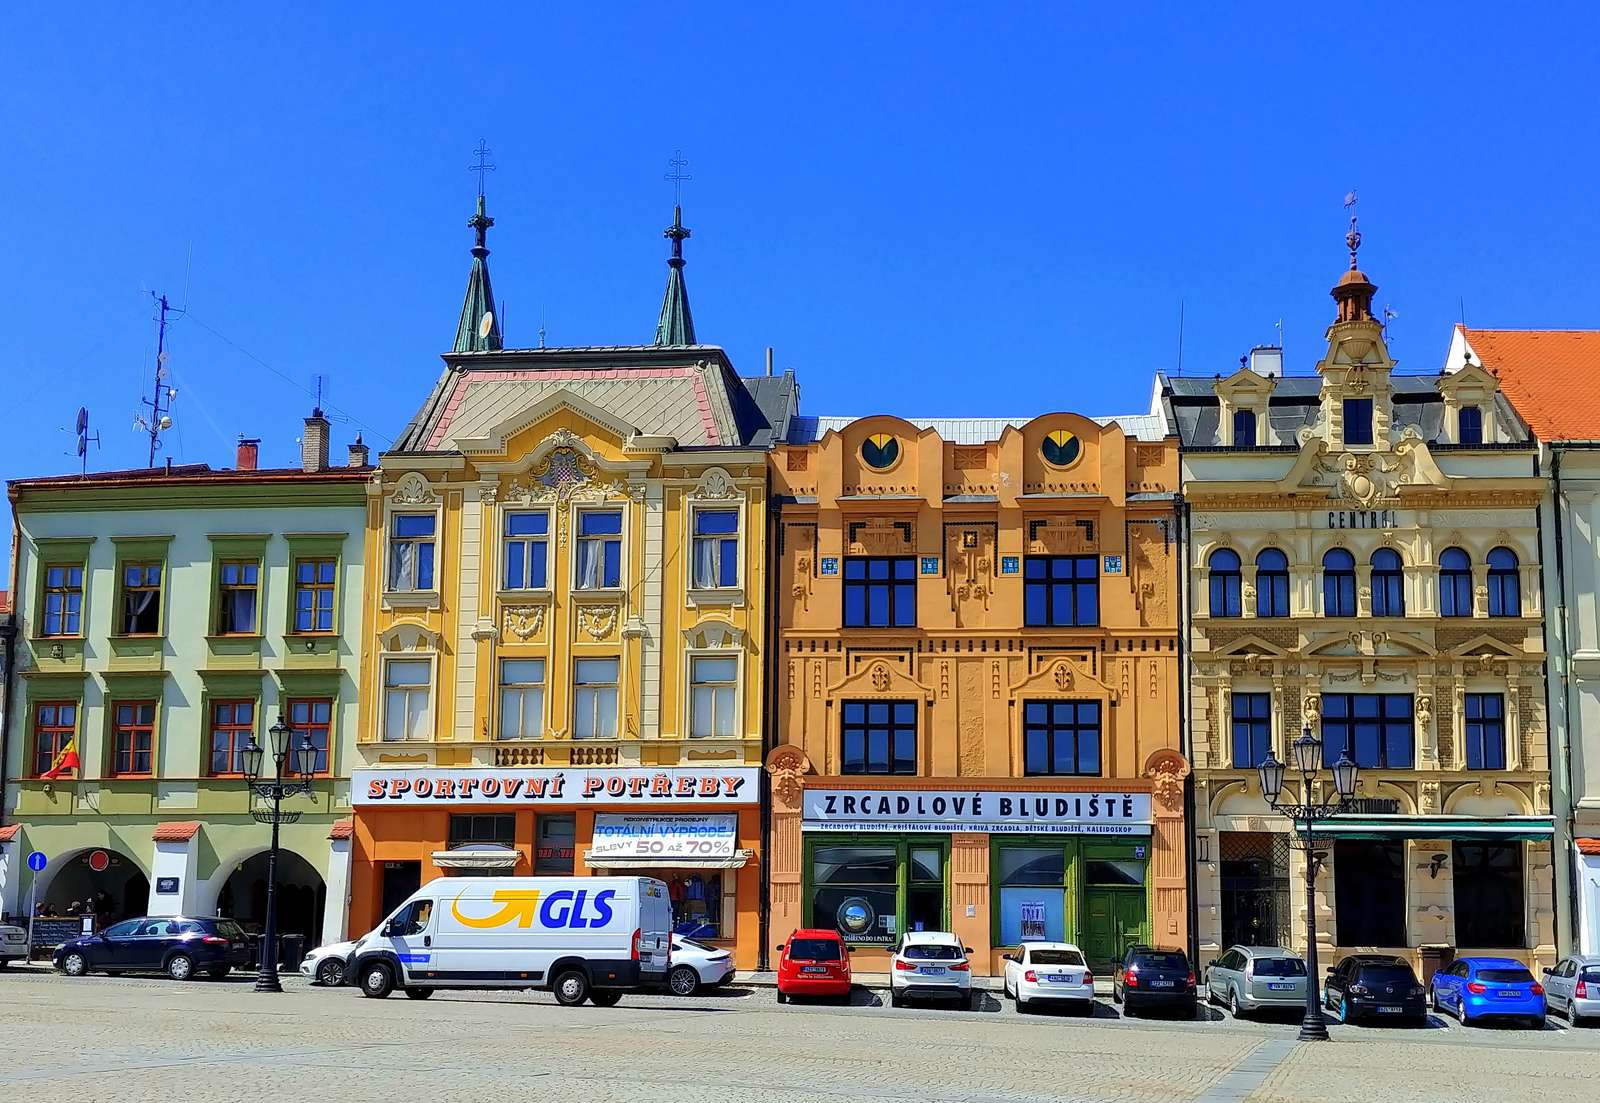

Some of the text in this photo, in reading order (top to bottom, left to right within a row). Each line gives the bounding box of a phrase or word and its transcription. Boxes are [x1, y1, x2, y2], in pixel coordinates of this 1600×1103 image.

[368, 772, 745, 799] SPORTOVNÍ POTŘEBY
[825, 793, 1133, 817] ZRCADLOVÉ BLUDIŠTĚ
[596, 824, 735, 838] TOTÁLNÍ VÝPRODEJ
[595, 840, 730, 854] SLEVY 50 AŽ 70%
[540, 889, 616, 929] GLS
